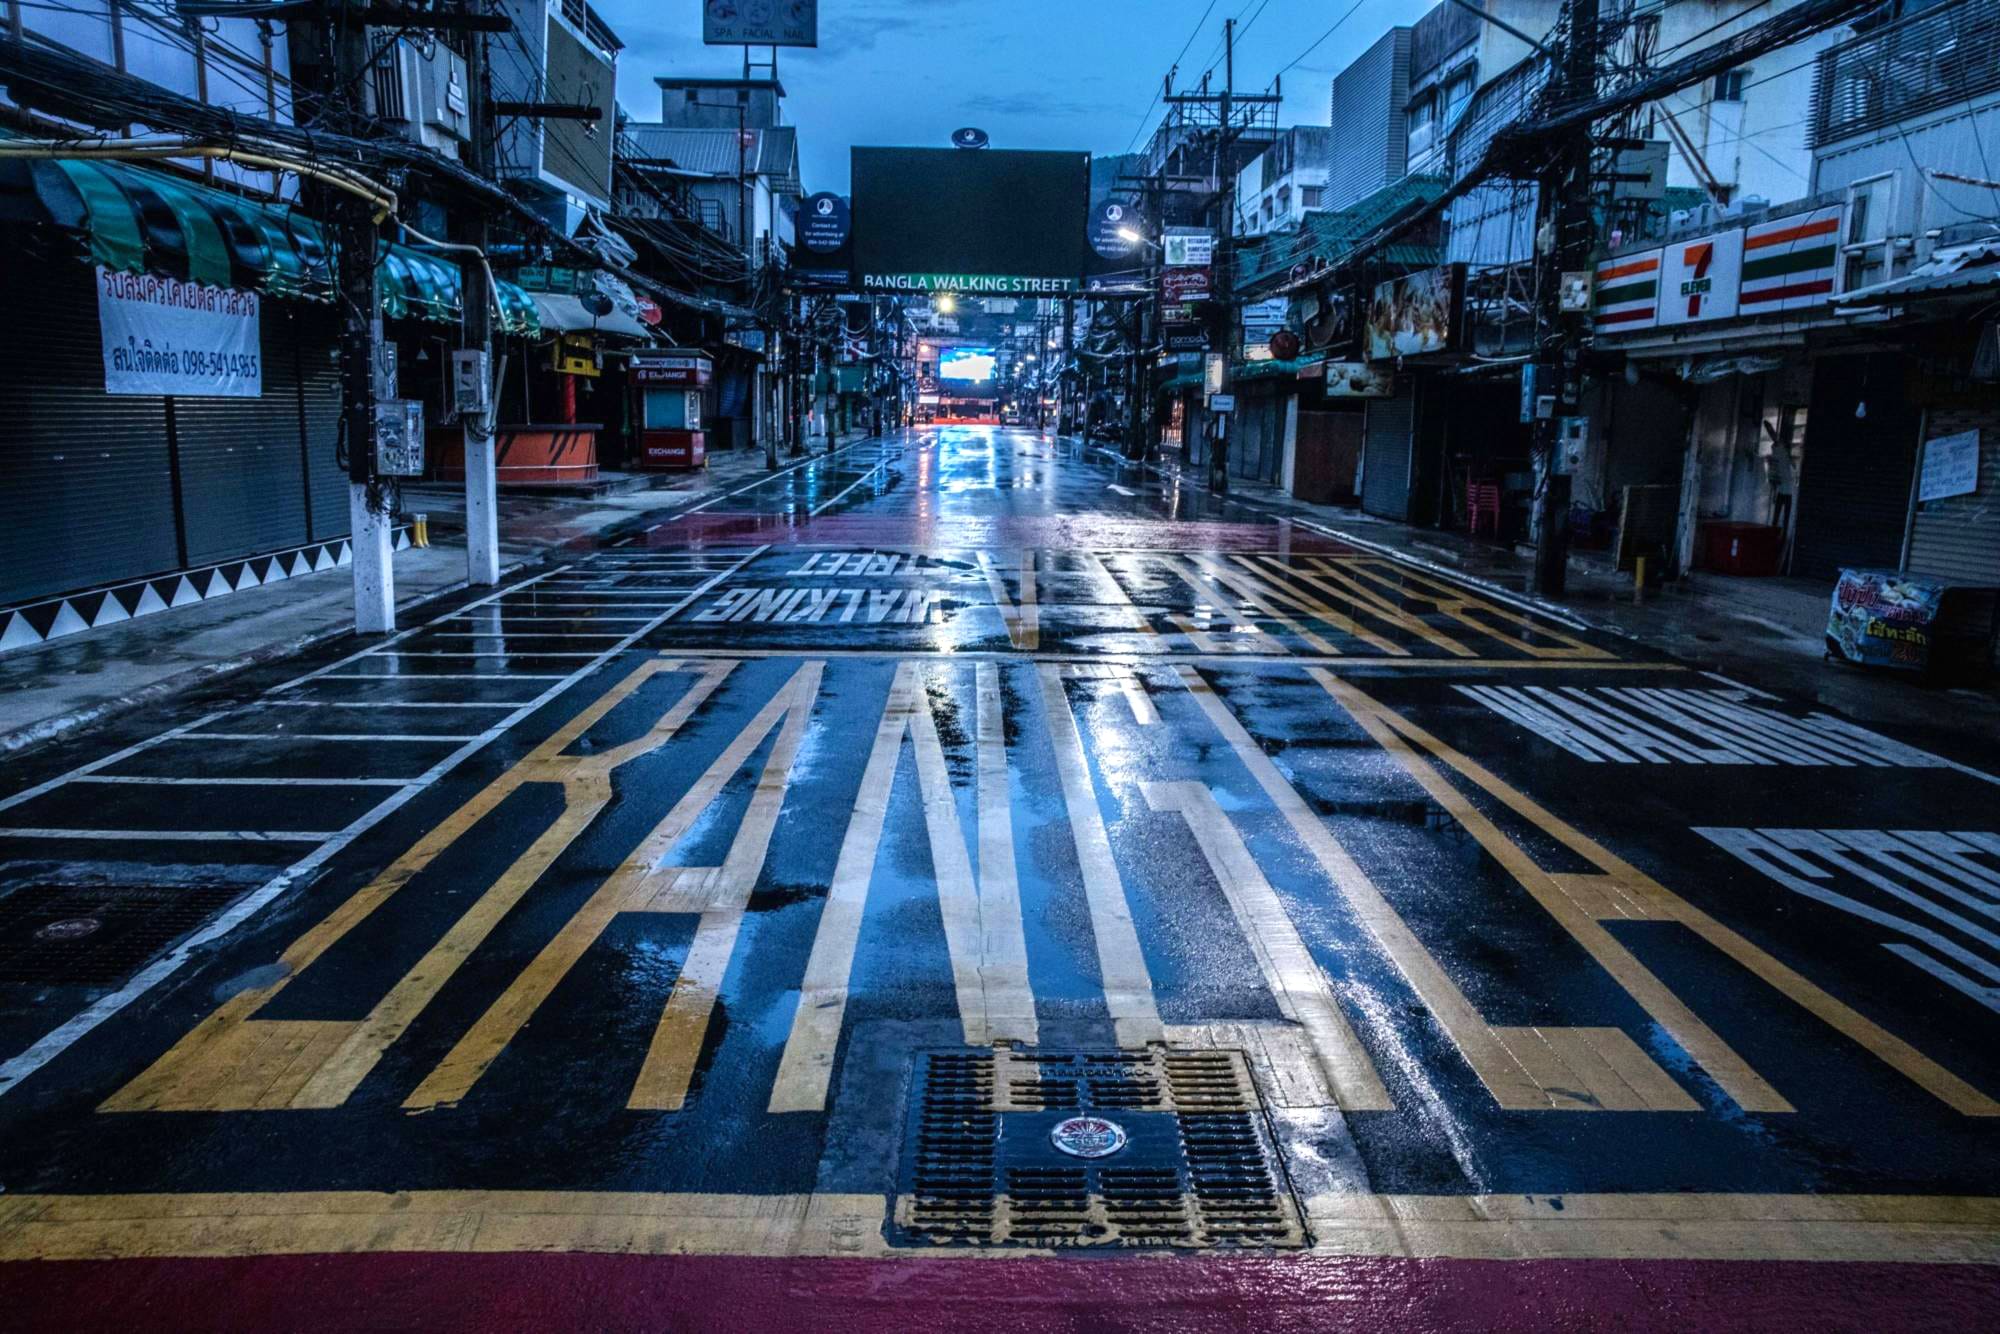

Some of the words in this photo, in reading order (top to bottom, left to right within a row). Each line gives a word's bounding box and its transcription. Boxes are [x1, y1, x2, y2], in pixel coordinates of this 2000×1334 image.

[712, 27, 733, 39] SPA
[743, 28, 776, 39] FACIAL
[783, 28, 807, 40] NAIL
[864, 275, 928, 290] BANGLA
[933, 276, 1008, 291] WALKING
[1012, 278, 1071, 292] STREET
[1684, 242, 1714, 318] 7
[113, 335, 179, 375] สนใจติดต่อ
[648, 447, 687, 456] EXCHANGE
[692, 588, 944, 623] WALKING
[97, 657, 2000, 1117] BANGLA
